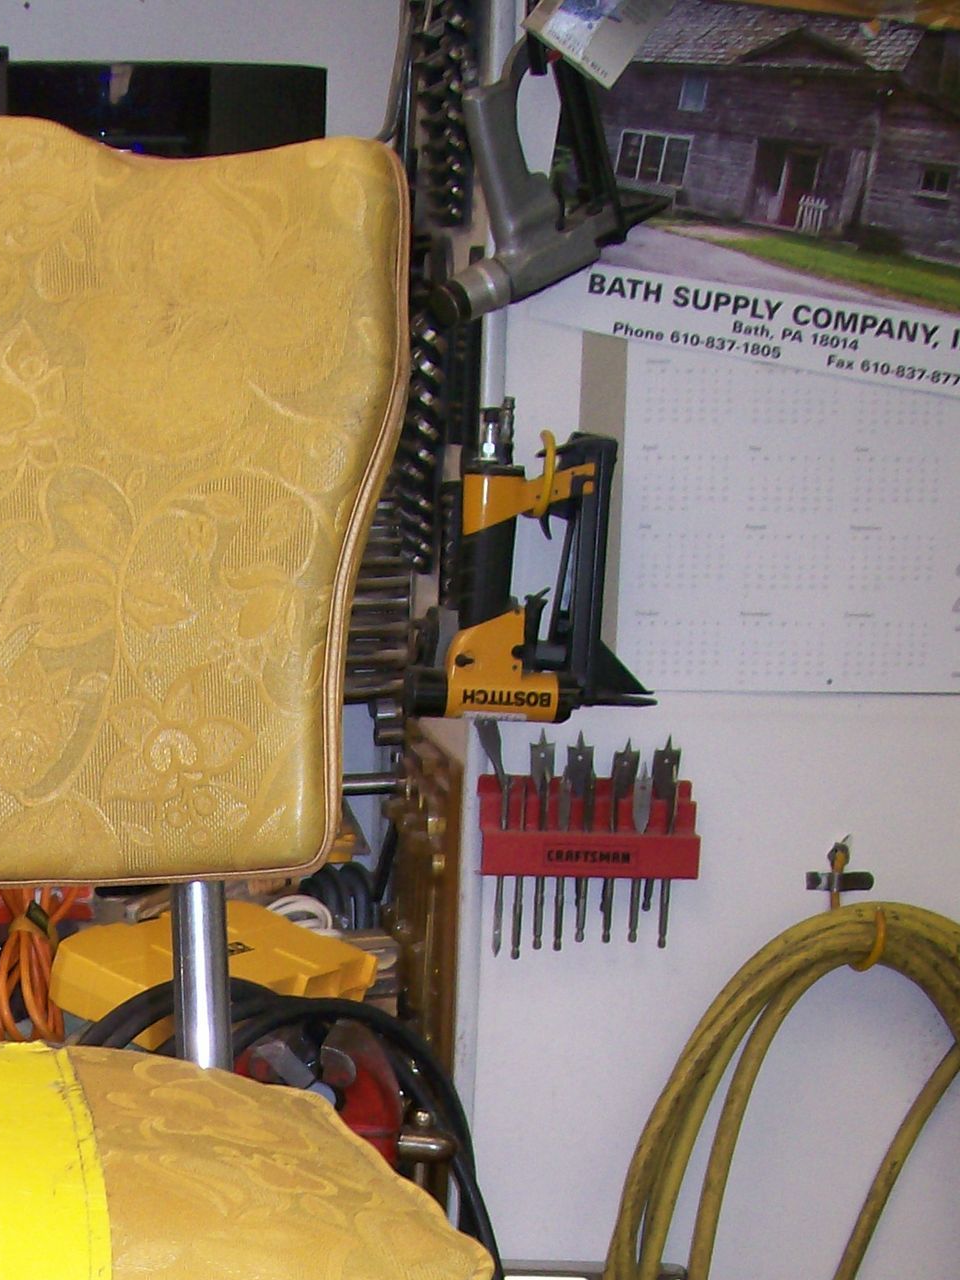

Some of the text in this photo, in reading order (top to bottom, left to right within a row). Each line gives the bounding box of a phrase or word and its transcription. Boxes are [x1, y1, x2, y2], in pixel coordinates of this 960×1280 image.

[588, 273, 960, 350] BATH SUPPLY COMPANY, I
[613, 321, 664, 341] Phone
[670, 331, 782, 359] 610-837-1805
[826, 354, 855, 370] Fax
[732, 320, 859, 351] Bath, PA 18014
[462, 689, 552, 707] BOSTITCH
[547, 850, 630, 864] CRAFTSMAN
